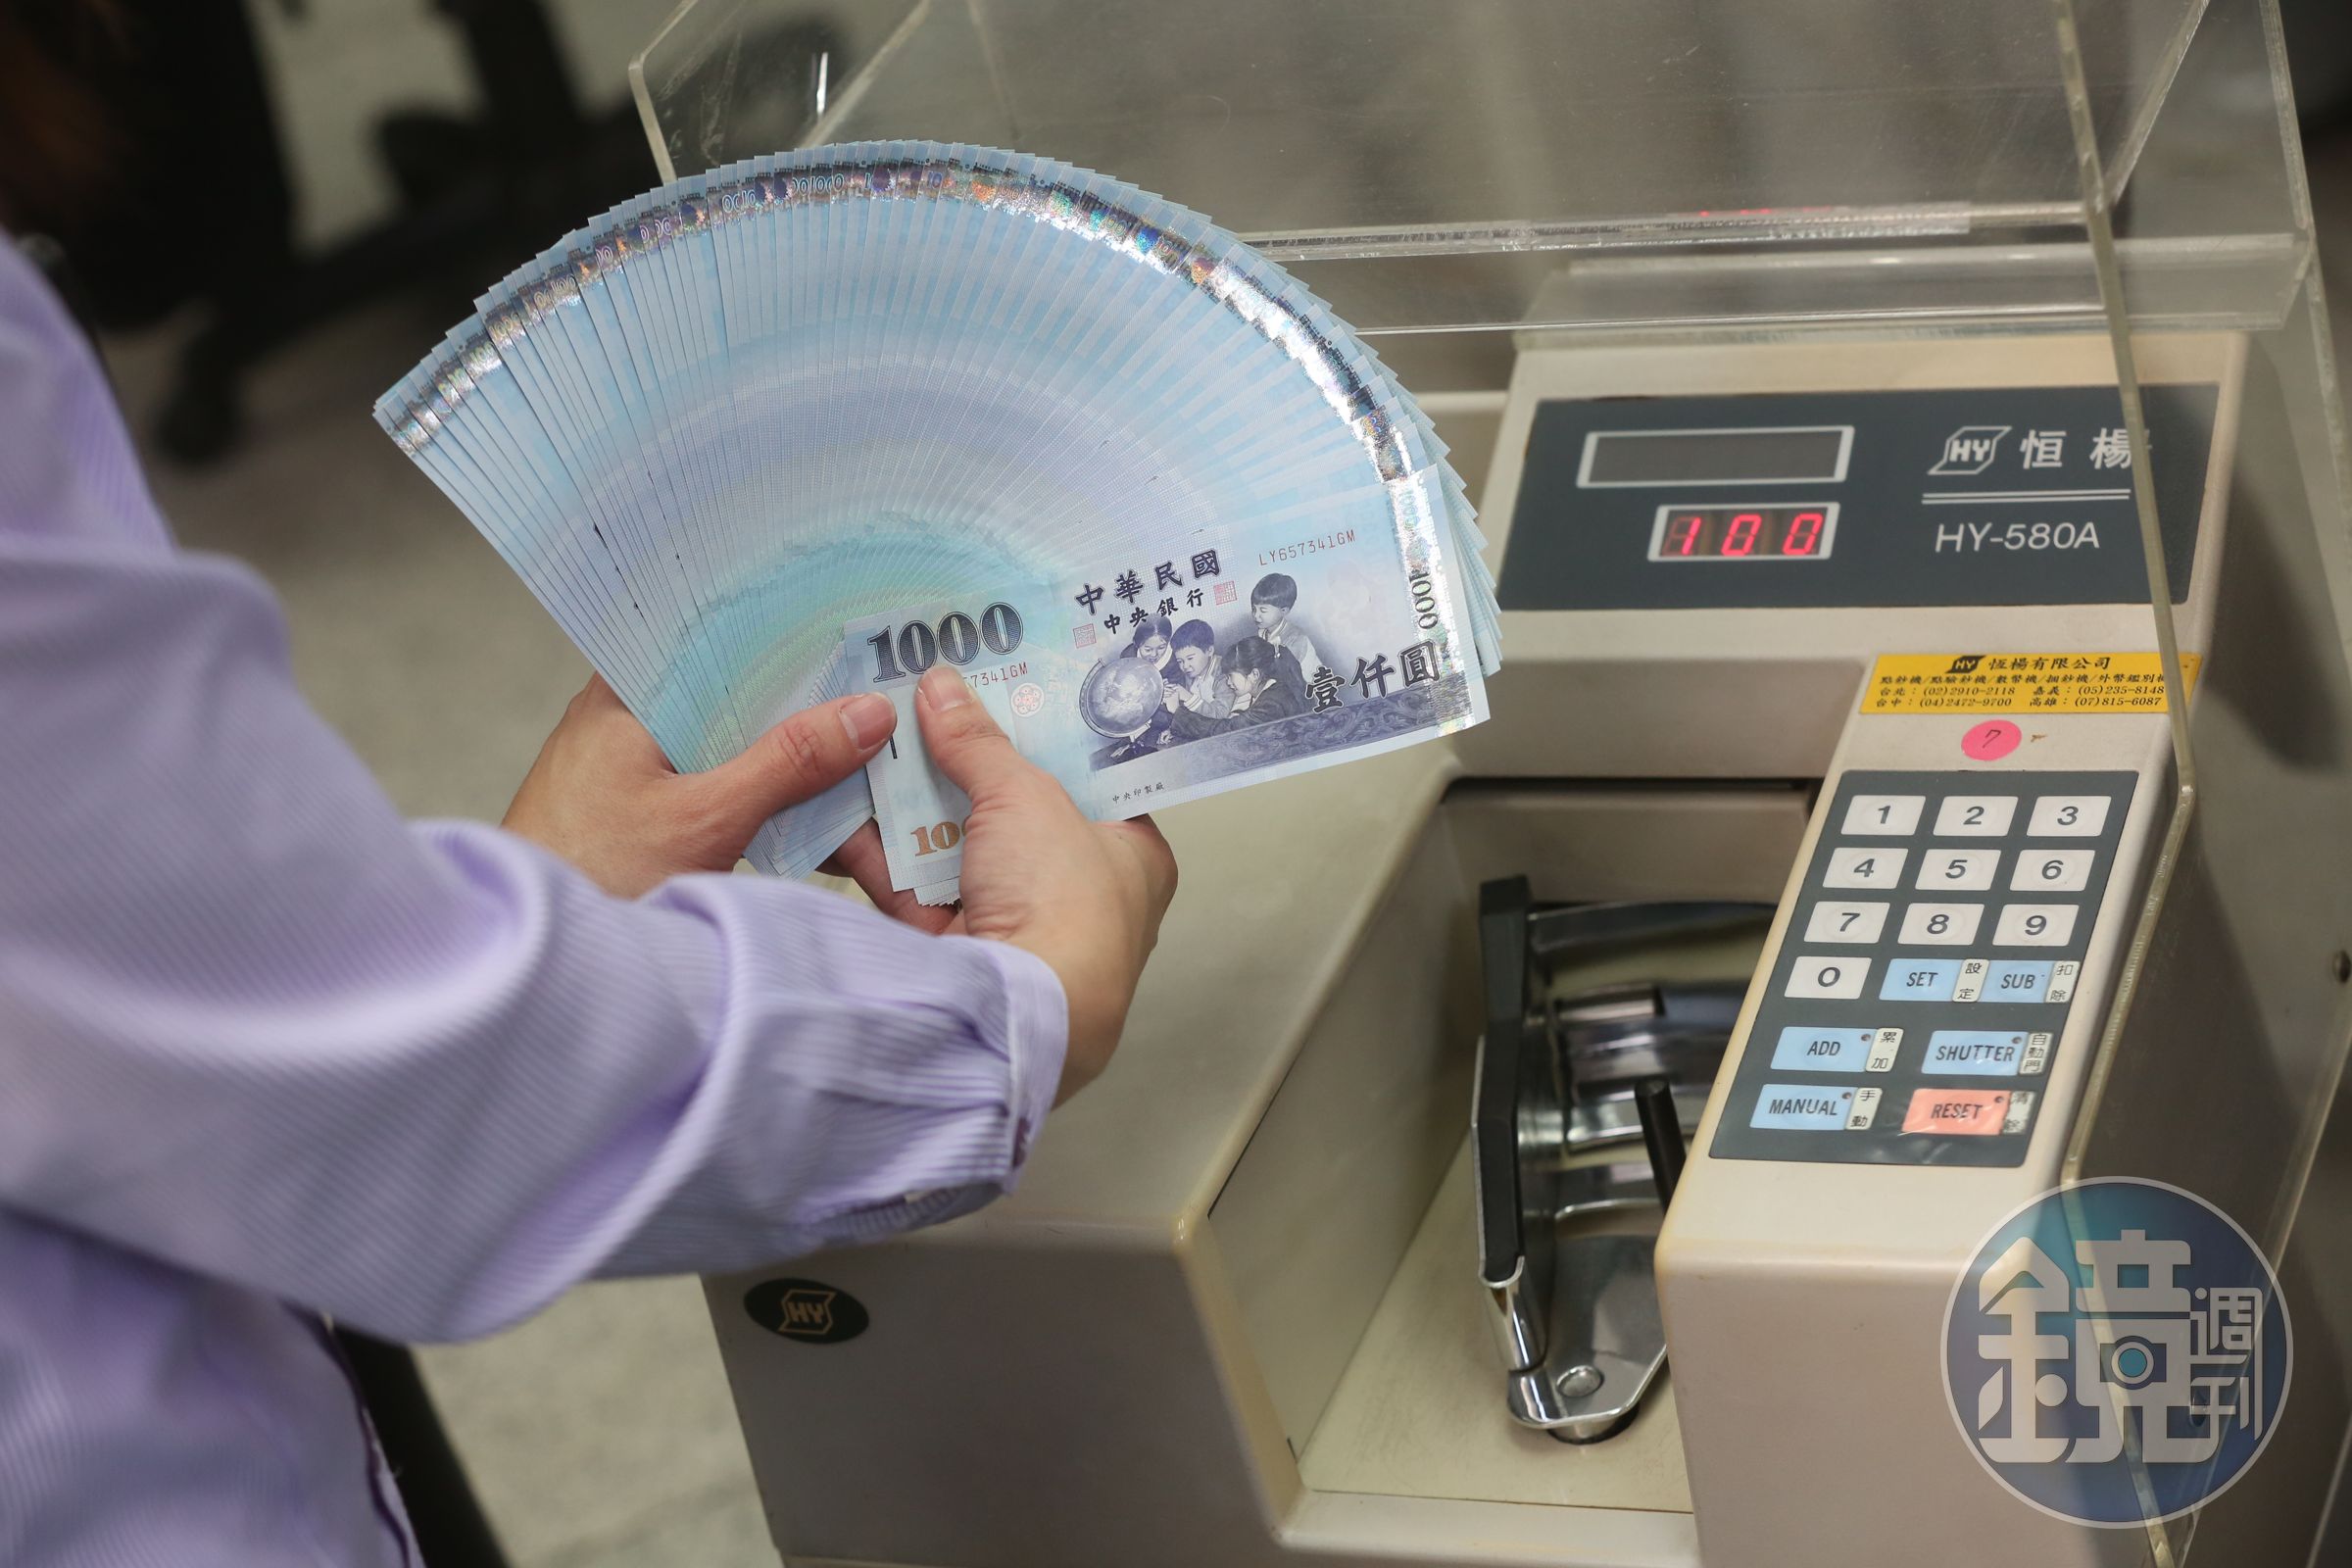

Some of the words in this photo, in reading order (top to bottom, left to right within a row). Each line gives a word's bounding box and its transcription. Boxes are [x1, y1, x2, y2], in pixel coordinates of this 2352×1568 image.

[1949, 439, 1990, 462] HY
[1678, 513, 1824, 557] 100
[1935, 521, 2100, 553] HY-580A
[1257, 529, 1356, 567] LY657341GM
[1075, 549, 1221, 615] 中華民國
[1408, 568, 1439, 630] 1000
[1103, 588, 1204, 634] 中央銀行
[866, 601, 1024, 684] 1000
[963, 662, 1029, 689] 7341GM
[1304, 639, 1443, 714] 壹仟圓
[2075, 697, 2162, 707] (07)815-6087
[1982, 729, 2002, 749] 7
[1877, 805, 1892, 824] 1
[1963, 806, 1984, 825] 2
[2056, 806, 2080, 826] 3
[910, 814, 971, 857] 10
[1853, 858, 1876, 877] 4
[1944, 858, 1968, 880] 5
[2041, 859, 2064, 880] 6
[1838, 911, 1861, 932] 7
[1926, 913, 1950, 934] 8
[2024, 914, 2048, 936] 9
[1816, 966, 1841, 988] 0
[1906, 971, 1938, 988] SET
[1957, 962, 1984, 1001] 設定
[2000, 974, 2035, 990] SUB
[2050, 964, 2074, 1002] 扣除
[1807, 1041, 1840, 1056] ADD
[1871, 1031, 1897, 1069] 累加
[1936, 1045, 2015, 1062] SHUTTER
[2025, 1033, 2047, 1072] 自動門
[1769, 1099, 1838, 1117] MANUAL
[1850, 1090, 1876, 1128] 手動
[1931, 1103, 1984, 1120] RESET
[786, 1300, 824, 1324] HY
